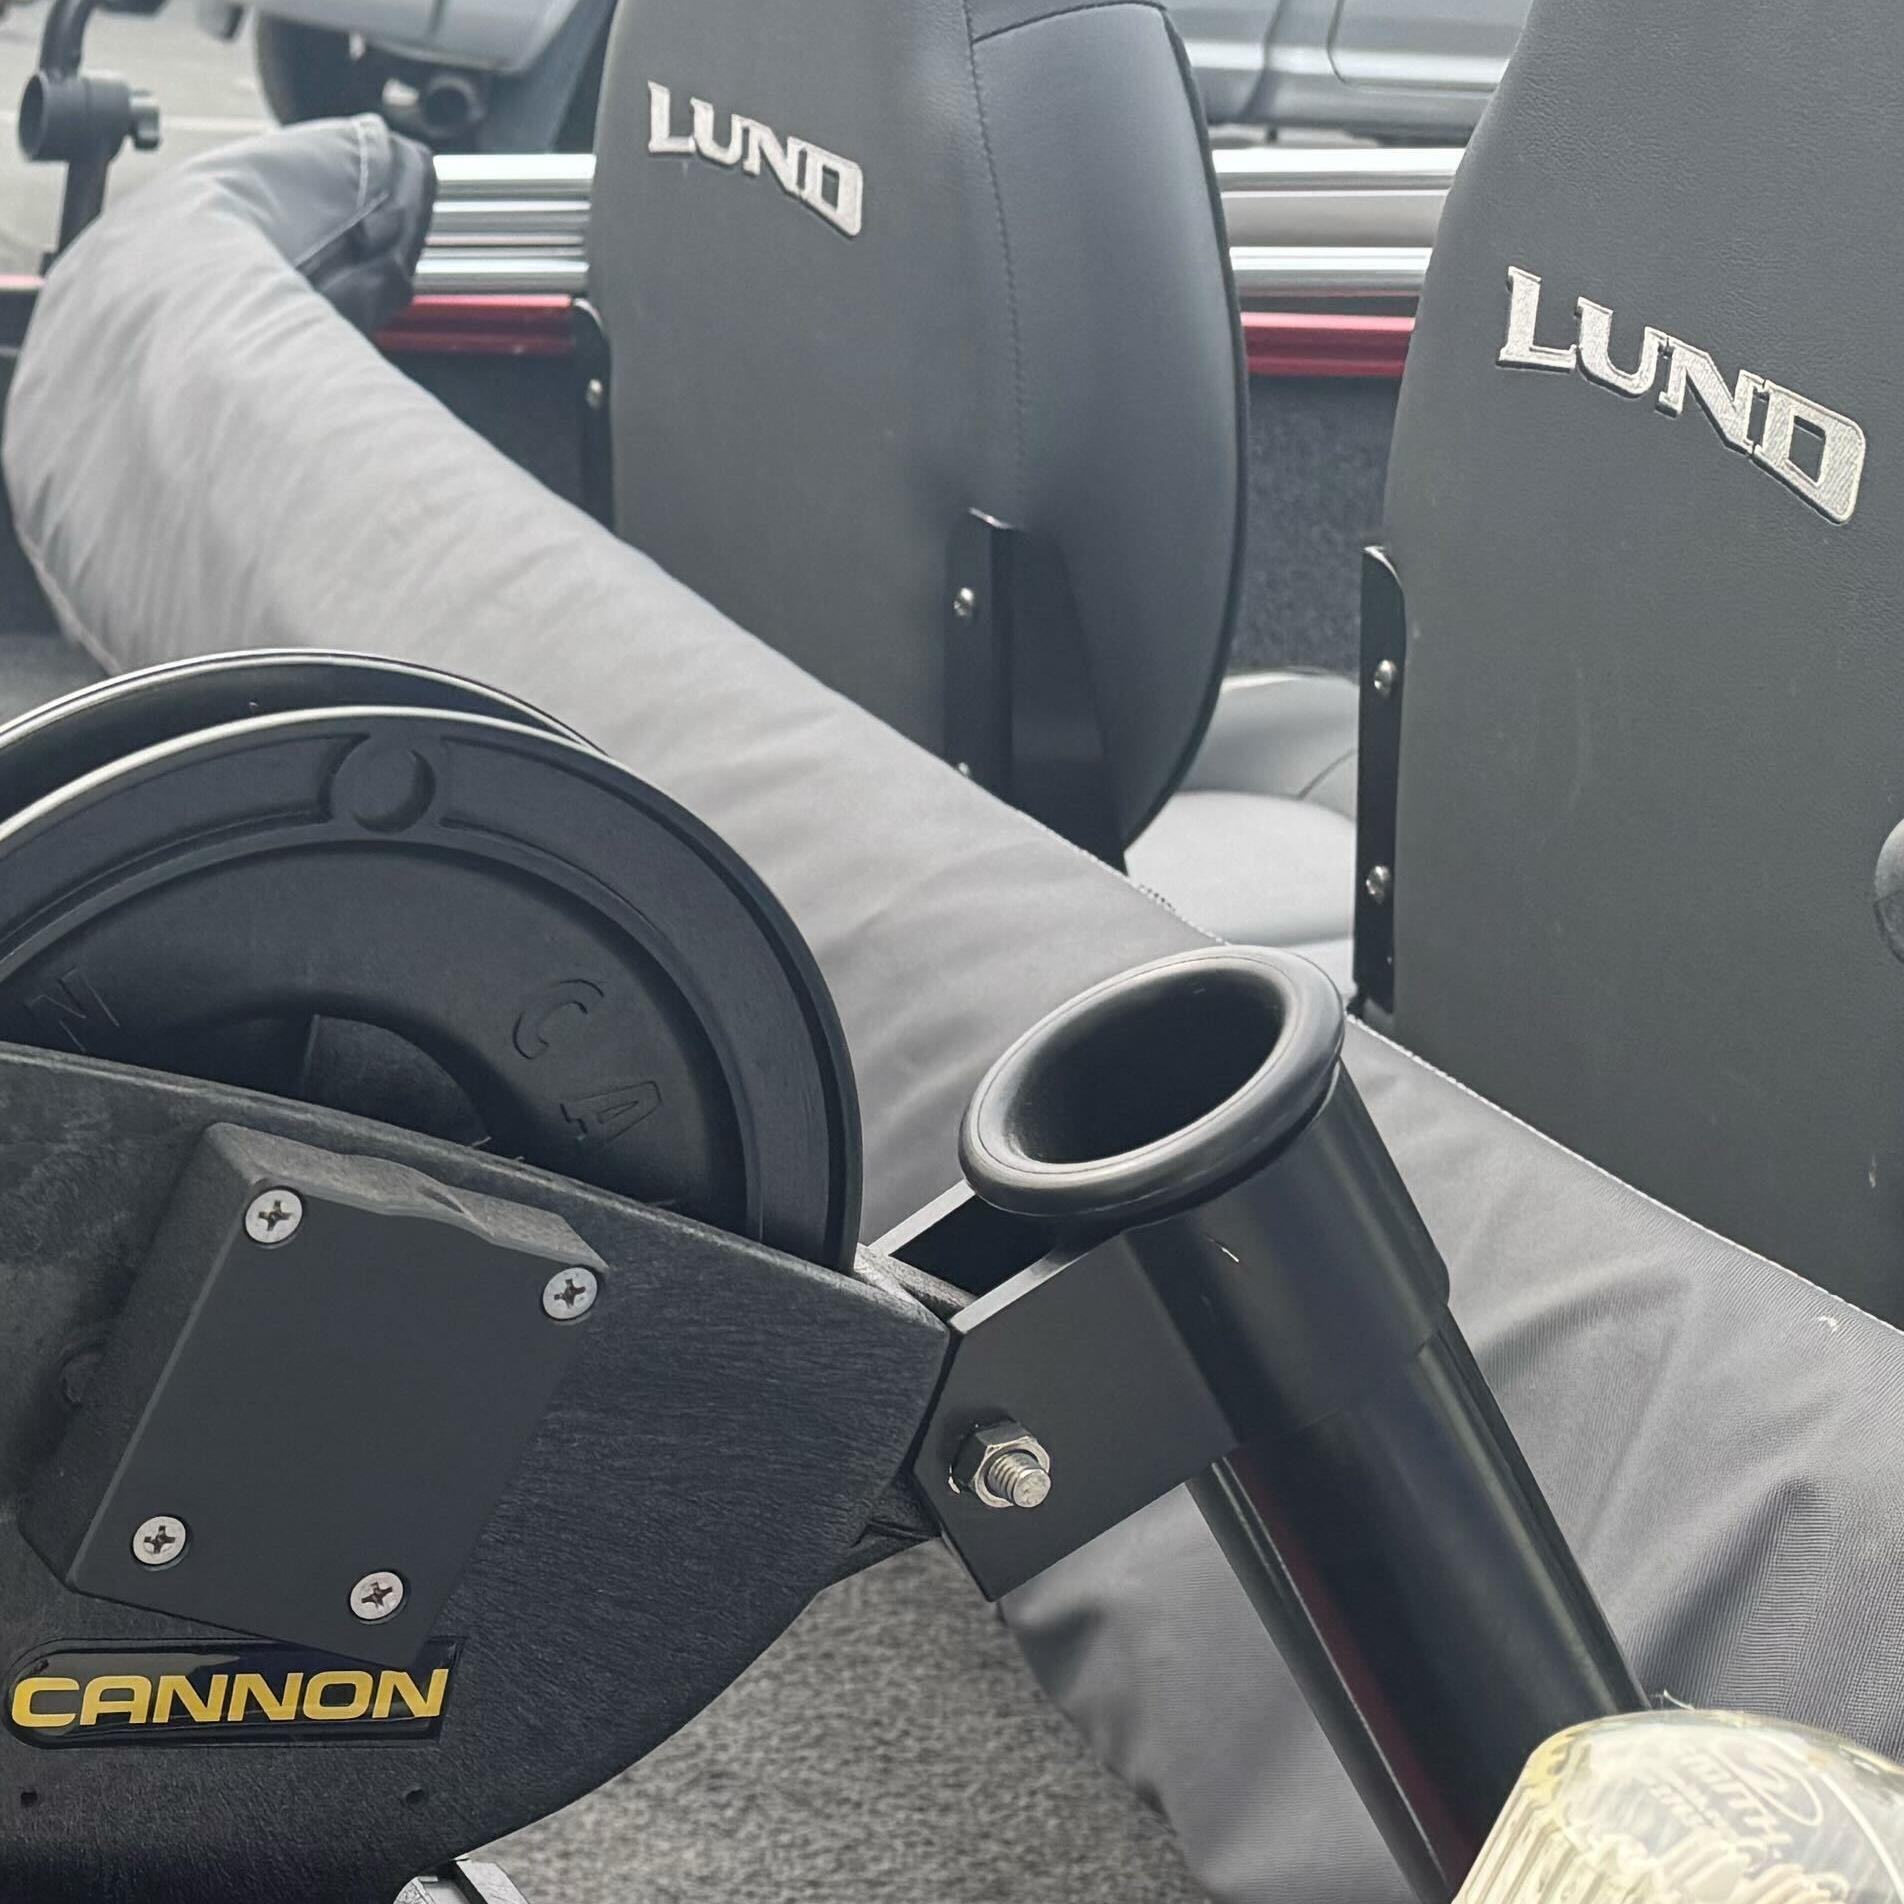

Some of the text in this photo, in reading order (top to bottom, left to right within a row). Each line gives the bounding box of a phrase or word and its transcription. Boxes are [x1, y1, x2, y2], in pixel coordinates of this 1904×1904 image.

[647, 80, 864, 238] LUND
[1496, 265, 1867, 526] LUND
[11, 1668, 449, 1728] CANNON
